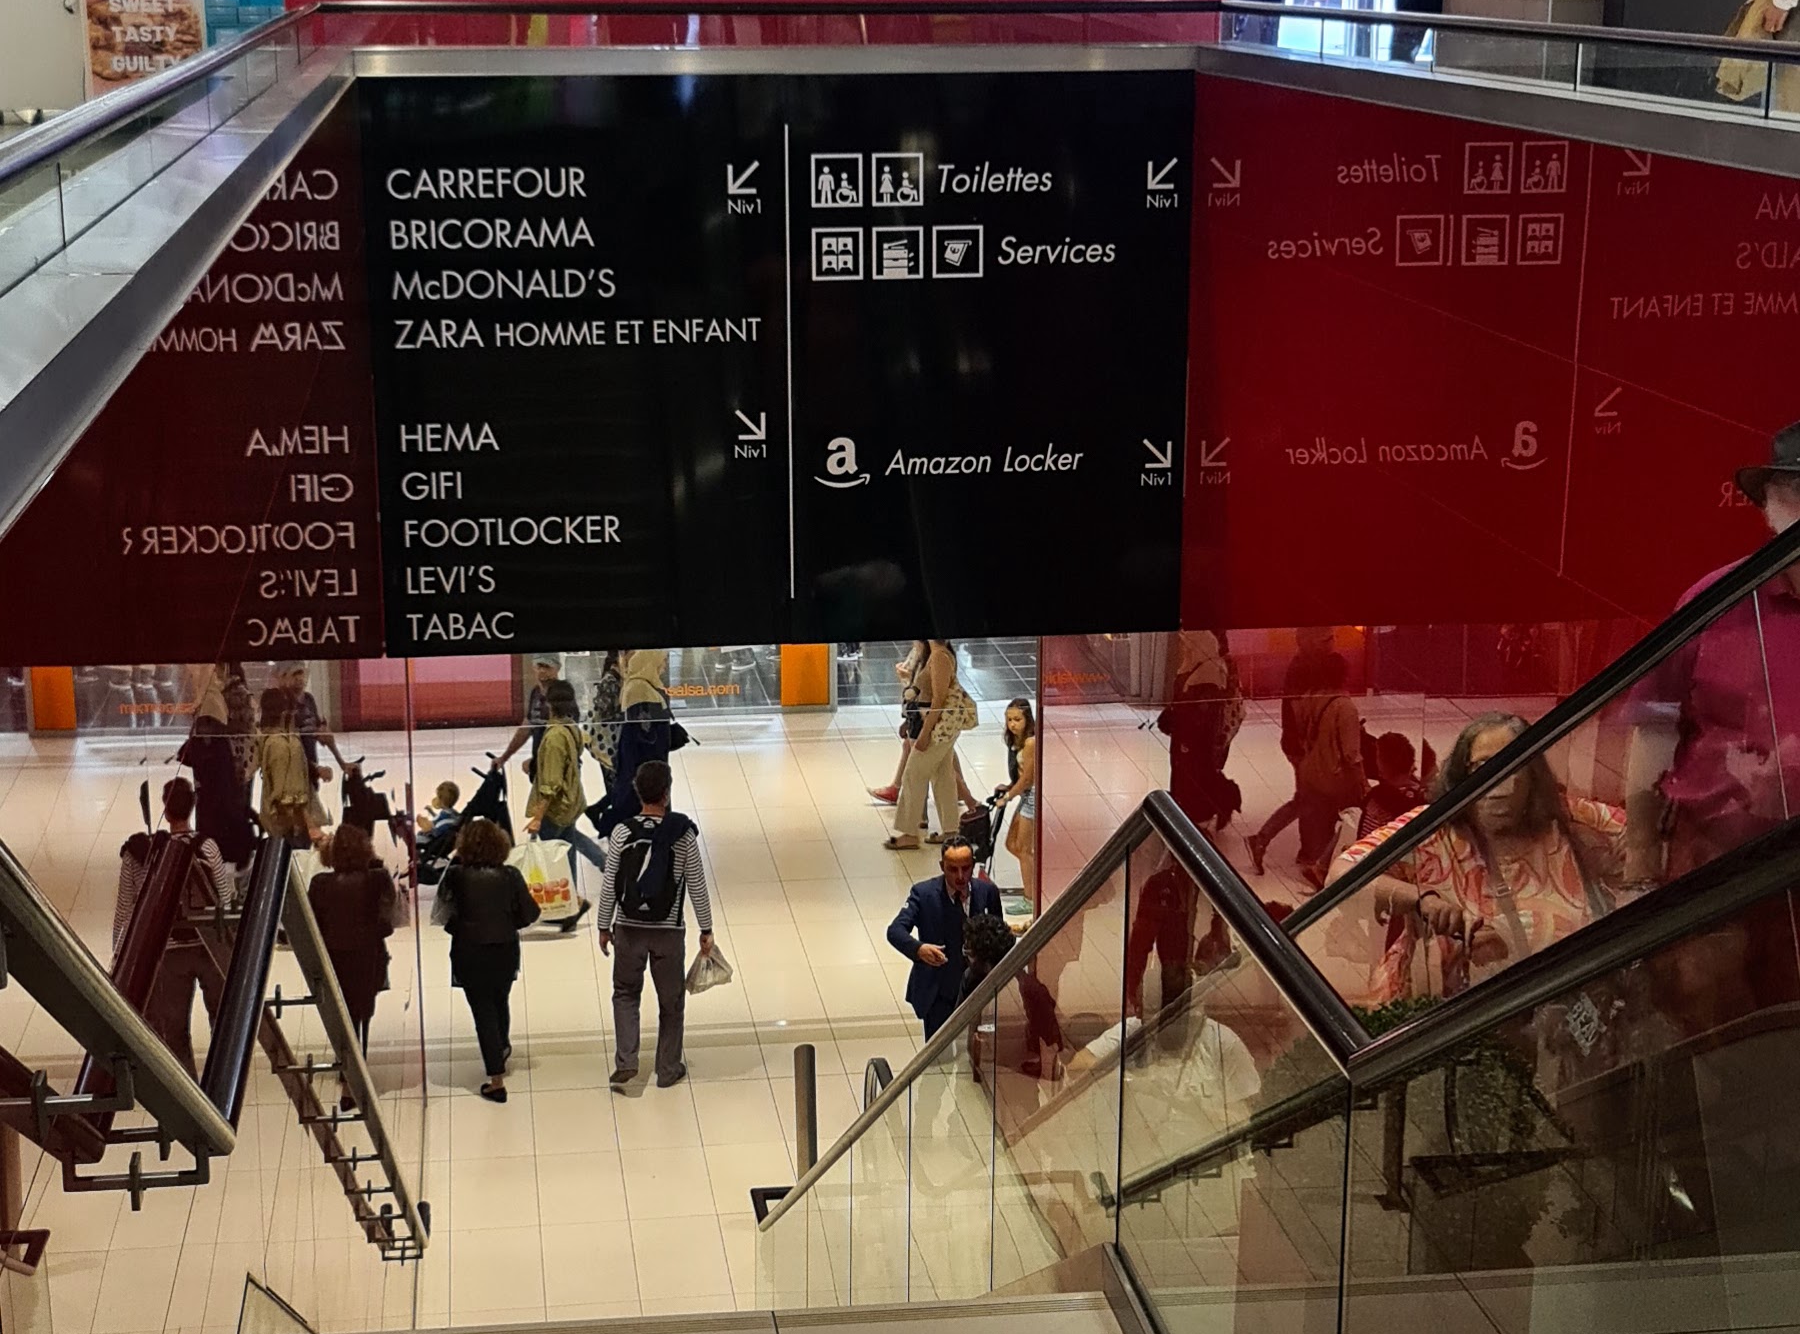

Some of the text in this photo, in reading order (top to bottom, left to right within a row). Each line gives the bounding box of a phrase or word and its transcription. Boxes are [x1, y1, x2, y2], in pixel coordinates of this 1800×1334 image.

[111, 24, 178, 43] TASTY
[388, 168, 586, 199] CARREFOUR
[938, 162, 1051, 193] Toilettes
[728, 199, 761, 214] Niv1
[1147, 194, 1177, 207] Niv1
[391, 218, 594, 249] BRICORAMA
[998, 237, 1115, 264] Services
[393, 269, 615, 299] McDONALD'S
[396, 318, 761, 348] ZARA HOMME ET ENFANT
[401, 423, 499, 452] HEMA
[735, 445, 766, 458] Niv1
[885, 450, 991, 475] Amazon
[1004, 444, 1083, 471] Locker
[402, 472, 461, 500] GIFI
[1141, 473, 1171, 485] Niv1
[405, 516, 620, 547] FOOTLOCKER
[407, 566, 495, 594] LEVI'S
[407, 612, 514, 640] TABAC
